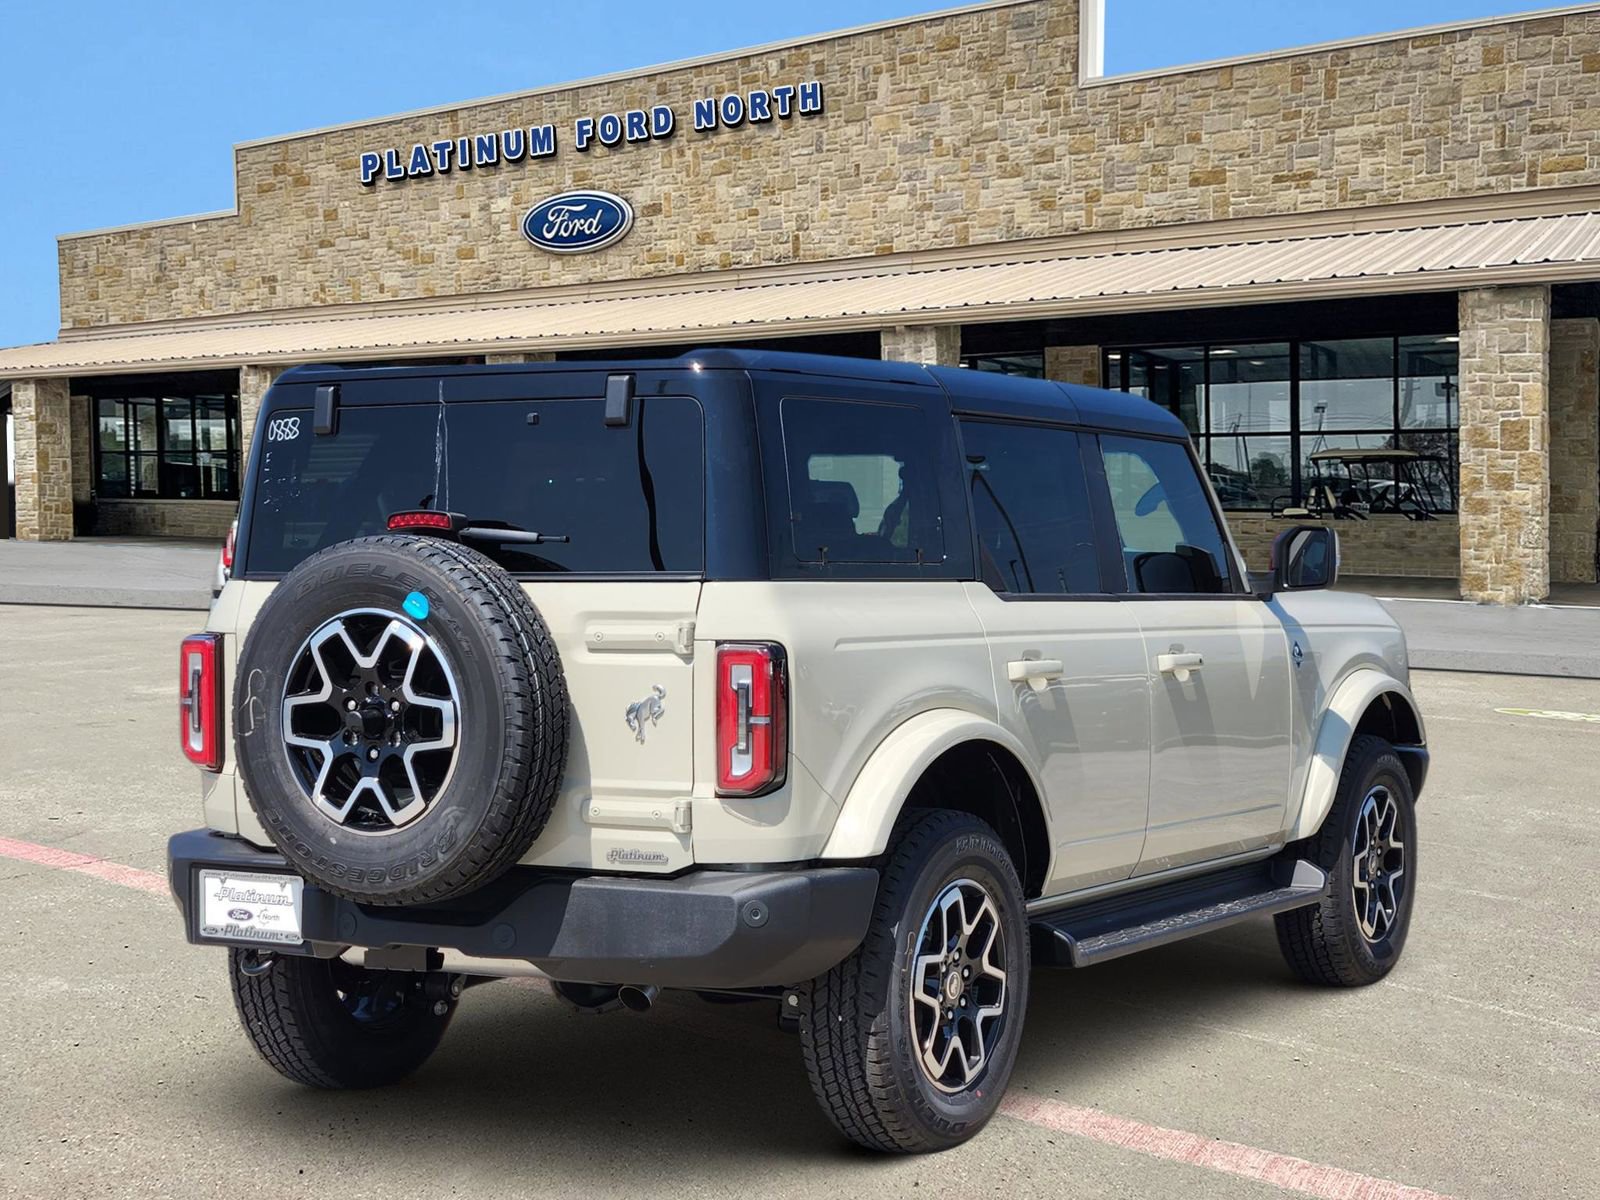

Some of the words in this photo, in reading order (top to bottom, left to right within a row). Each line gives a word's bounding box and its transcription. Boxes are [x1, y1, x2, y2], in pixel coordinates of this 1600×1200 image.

[360, 124, 556, 186] PLATINUM
[575, 106, 675, 149] FORD
[694, 81, 822, 131] NORTH
[542, 203, 603, 240] Ford
[264, 806, 462, 885] BRIDGESTONE
[606, 847, 669, 865] Platinum
[213, 886, 293, 906] Platinum
[262, 913, 280, 921] North
[223, 923, 283, 941] Platinum
